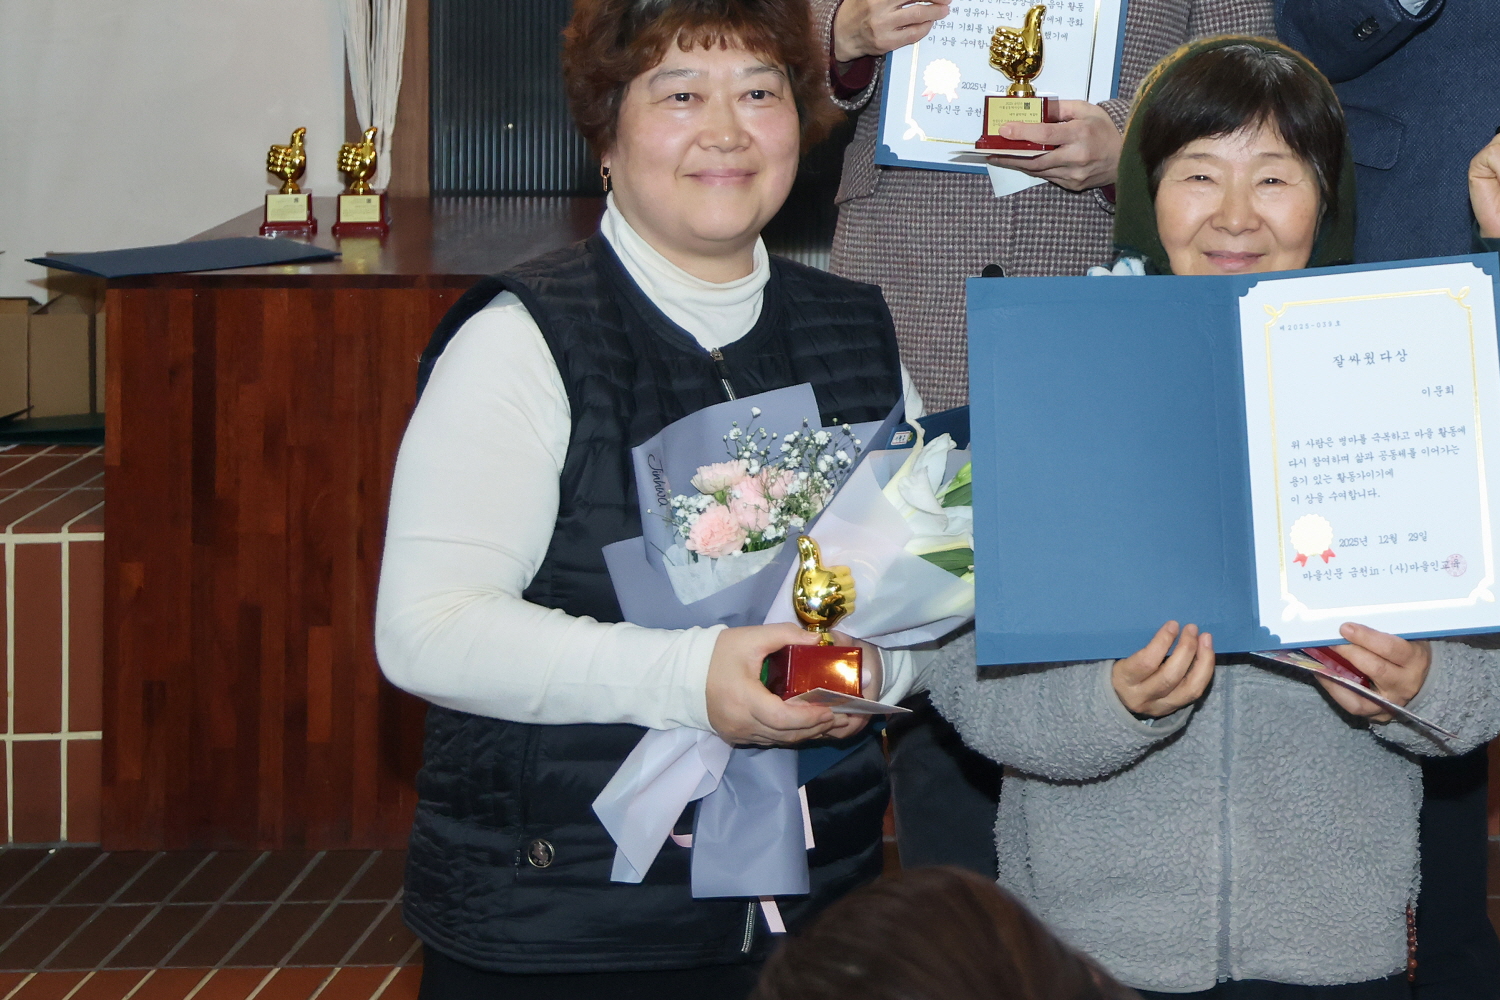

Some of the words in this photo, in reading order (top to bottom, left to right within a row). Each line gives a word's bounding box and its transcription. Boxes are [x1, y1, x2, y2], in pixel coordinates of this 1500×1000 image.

[1047, 0, 1065, 9] 음악
[1067, 1, 1084, 13] 활동
[963, 7, 989, 18] 영유아
[996, 10, 1014, 20] 노인
[1066, 16, 1084, 27] 문화
[959, 23, 984, 34] 기회를
[928, 35, 936, 44] 이
[939, 36, 957, 47] 상을
[961, 81, 987, 92] 2025년
[995, 84, 1007, 93] 12
[926, 103, 961, 116] 마을신문
[1291, 439, 1300, 450] 위
[1305, 436, 1334, 449] 사람은
[1338, 433, 1367, 447] 병마를
[1371, 430, 1410, 443] 극복하고
[1414, 427, 1434, 439] 마을
[1438, 425, 1467, 437] 활동에
[1288, 456, 1307, 468] 다시
[1312, 453, 1350, 467] 참여하며
[1354, 450, 1375, 464] 삶과
[1378, 446, 1417, 462] 공동체를
[1421, 444, 1460, 458] 이어가는
[1289, 474, 1308, 488] 용기
[1312, 472, 1333, 485] 있는
[1336, 467, 1395, 483] 활동가이기에
[1290, 493, 1300, 505] 이
[1304, 492, 1324, 505] 상을
[1328, 487, 1381, 502] 수여합니다.
[1338, 535, 1368, 548] 2025년
[1378, 533, 1398, 545] 12월
[1407, 530, 1428, 542] 29일
[1302, 567, 1343, 582] 마을신문
